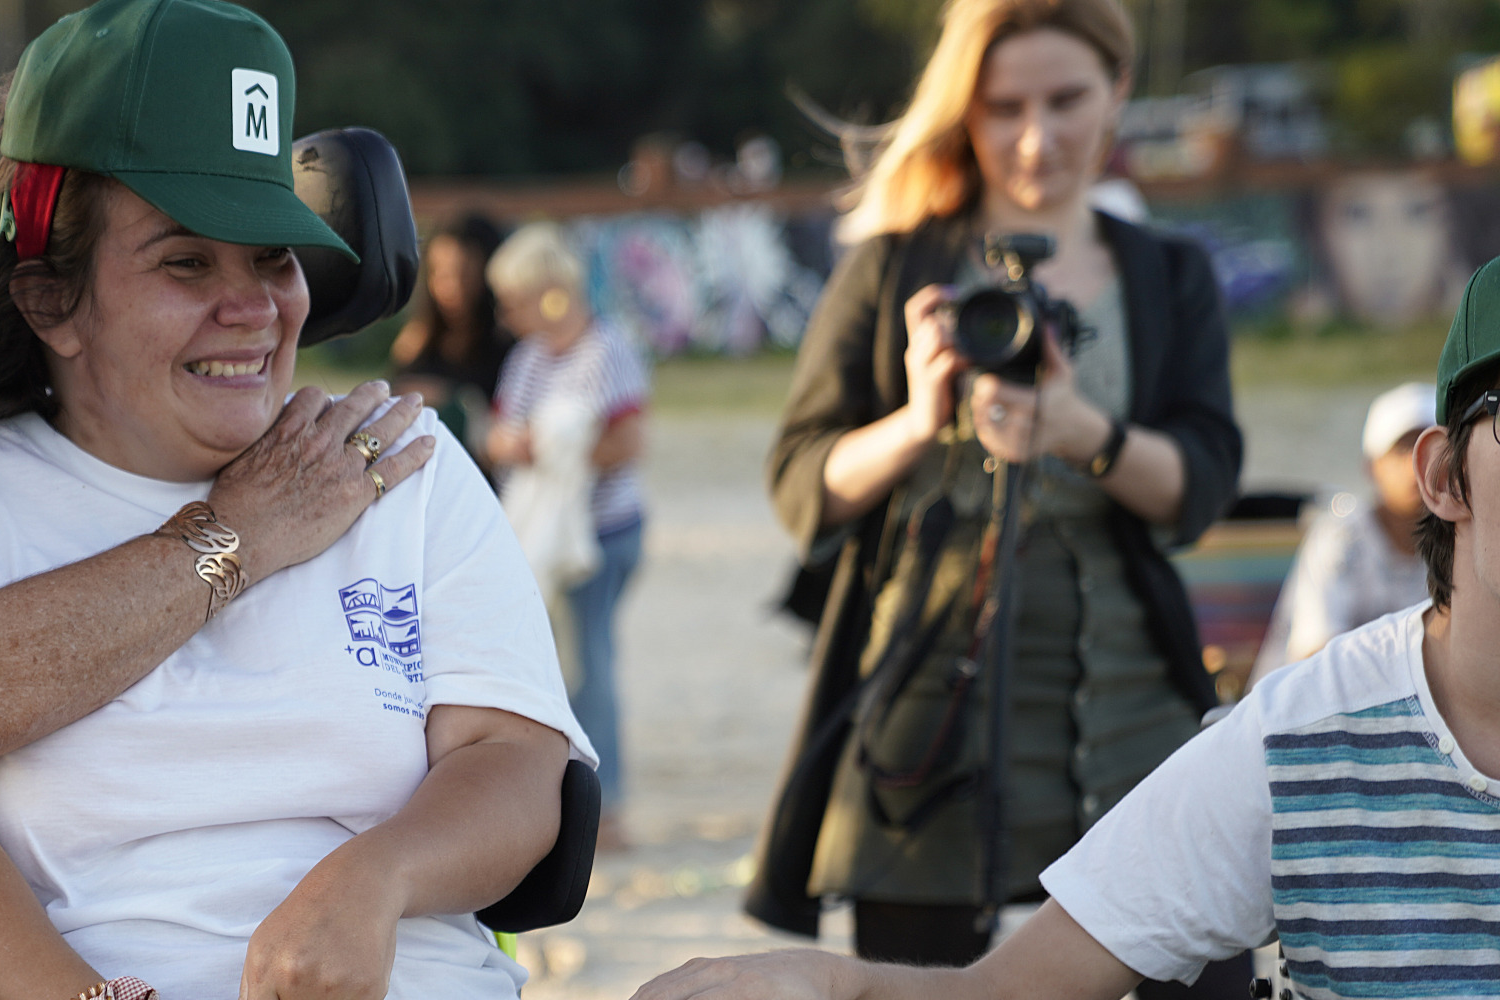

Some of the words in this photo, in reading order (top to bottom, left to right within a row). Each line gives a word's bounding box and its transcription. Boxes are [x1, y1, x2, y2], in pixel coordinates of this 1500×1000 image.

[246, 102, 268, 141] M
[374, 688, 402, 701] Donde
[383, 703, 409, 715] somos
